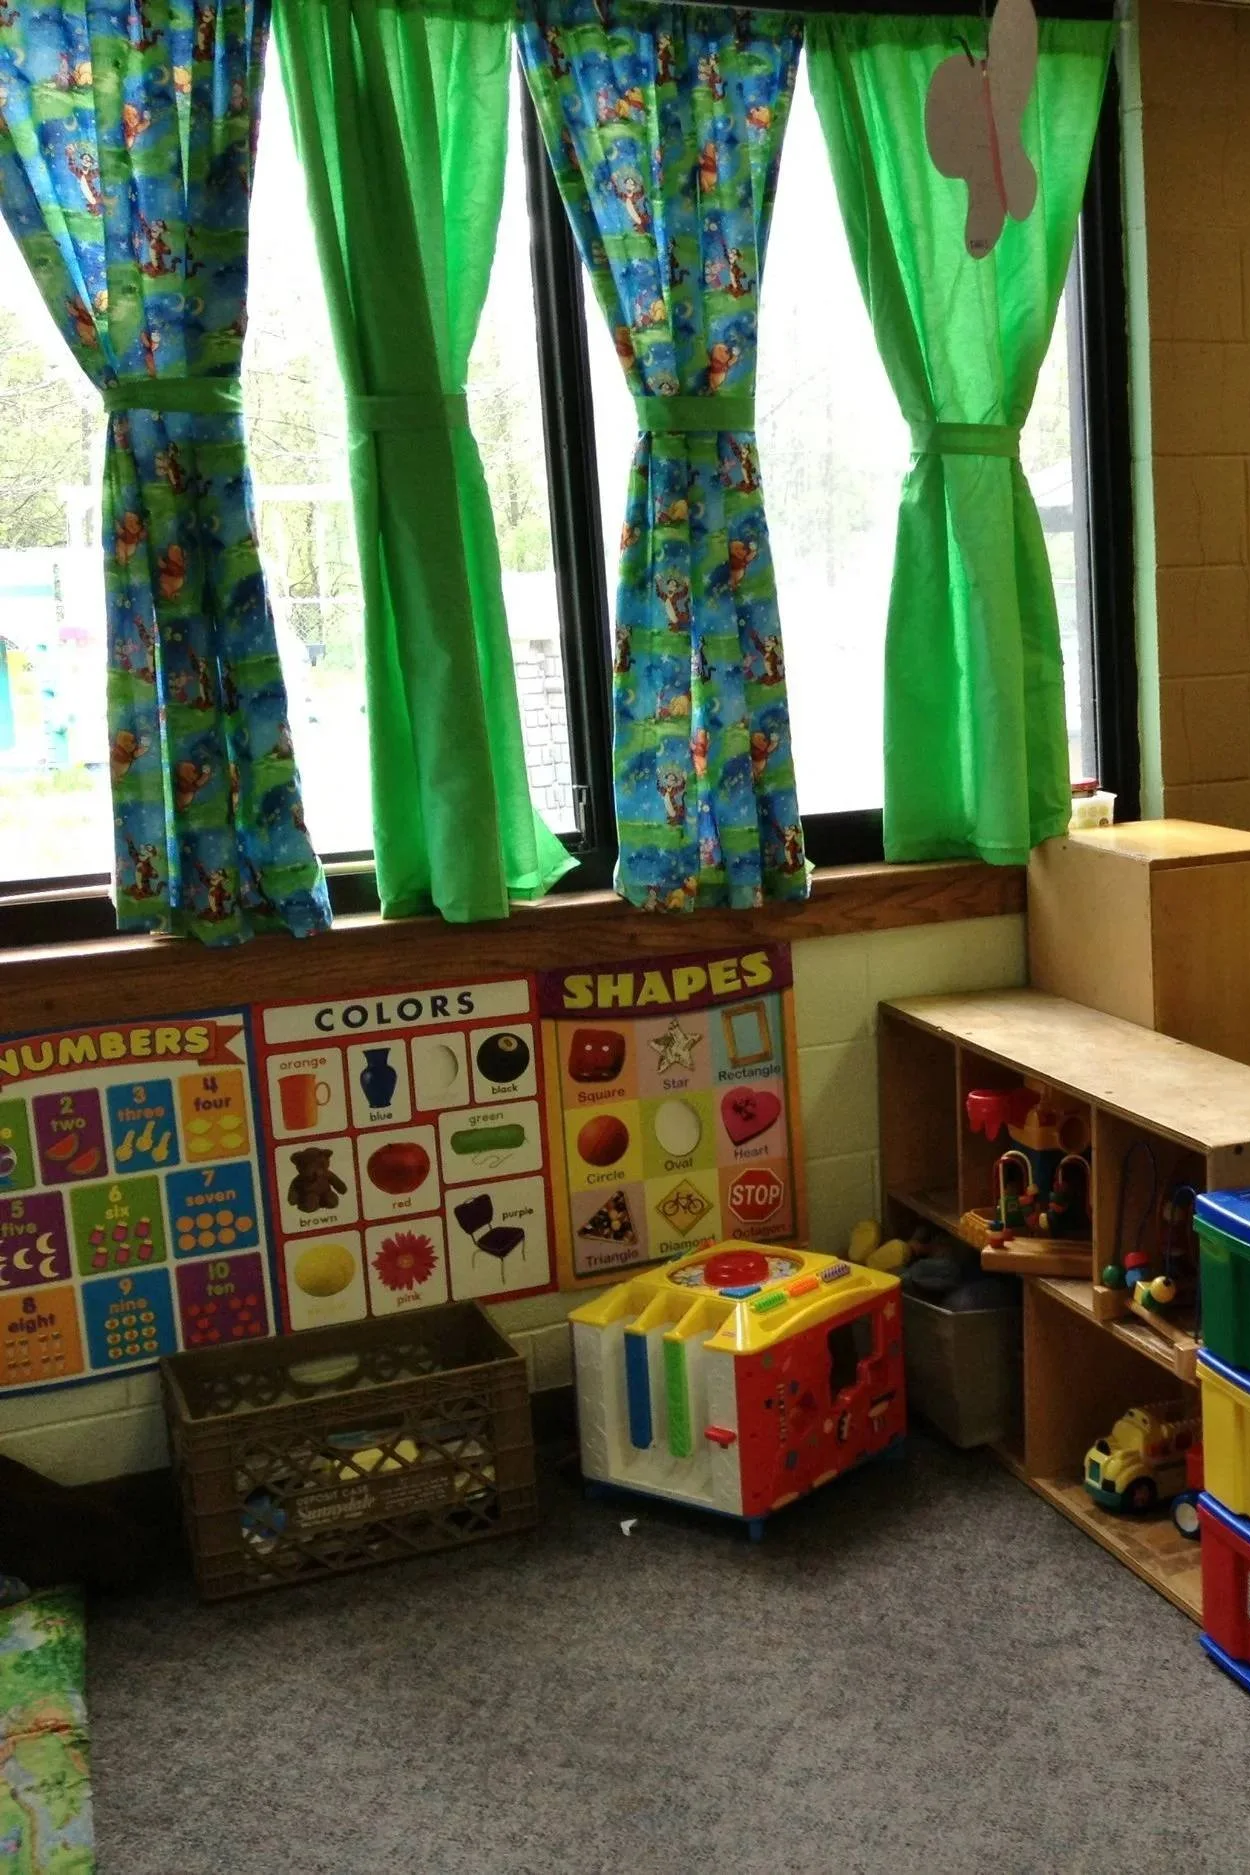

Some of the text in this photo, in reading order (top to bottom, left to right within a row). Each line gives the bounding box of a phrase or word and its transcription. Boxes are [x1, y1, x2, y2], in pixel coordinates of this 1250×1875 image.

[563, 952, 773, 1009] SHAPES
[315, 991, 475, 1032] COLORS
[279, 1055, 327, 1071] orange
[718, 1063, 781, 1082] Rectangle
[203, 1076, 219, 1093] 4
[491, 1083, 519, 1095] black
[663, 1077, 689, 1090] Star
[132, 1086, 146, 1103] 3
[194, 1095, 232, 1111] four
[577, 1086, 625, 1104] Square
[60, 1097, 74, 1114] 2
[118, 1105, 165, 1122] three
[51, 1116, 87, 1132] two
[369, 1111, 393, 1122] blue
[468, 1110, 504, 1126] green
[664, 1158, 693, 1172] Oval
[203, 1170, 216, 1187] 7
[586, 1169, 625, 1184] Circle
[109, 1185, 122, 1201] 6
[185, 1189, 236, 1206] seven
[731, 1184, 780, 1206] STOP
[11, 1200, 25, 1218] 5
[392, 1198, 412, 1210] red
[105, 1205, 131, 1221] six
[300, 1214, 338, 1228] brown
[502, 1207, 534, 1221] purple
[1, 1219, 37, 1236] five
[586, 1250, 639, 1269] Triangle
[208, 1263, 229, 1279] 10
[119, 1278, 133, 1295] 9
[206, 1281, 235, 1297] ten
[22, 1296, 37, 1314] 8
[109, 1297, 147, 1314] nine
[8, 1314, 56, 1335] eight
